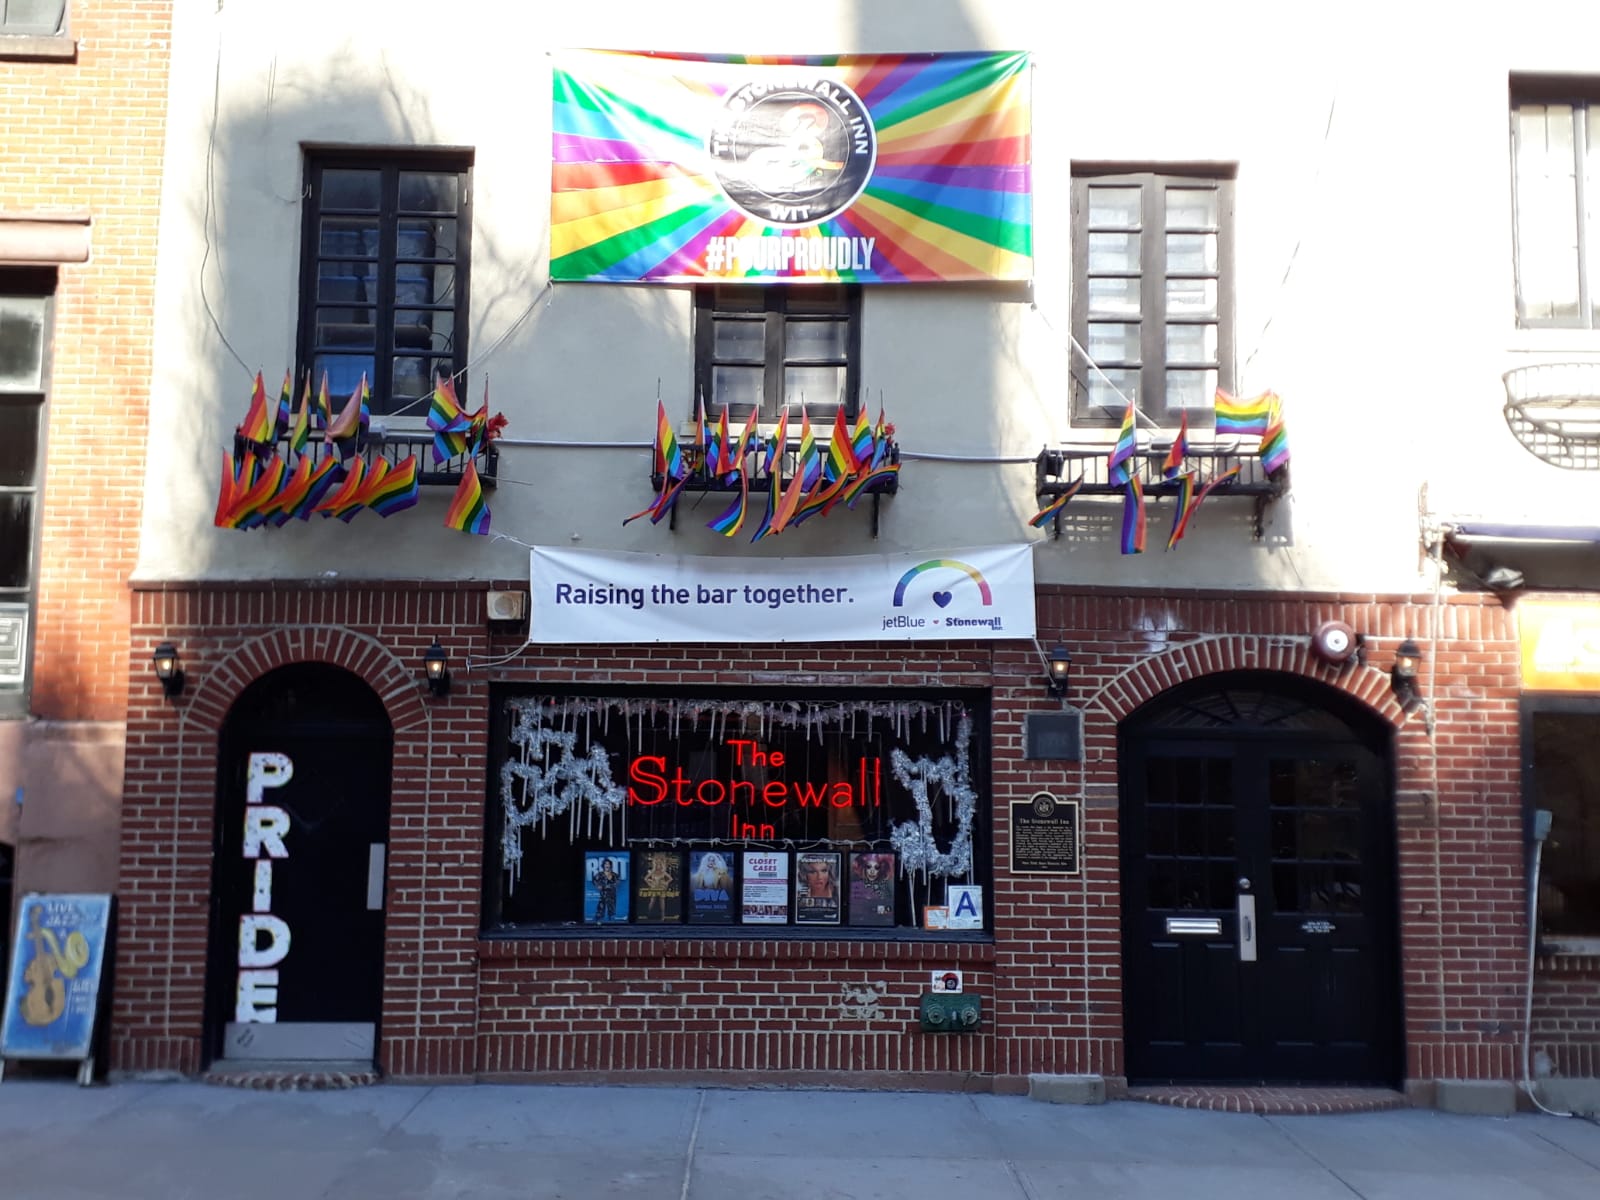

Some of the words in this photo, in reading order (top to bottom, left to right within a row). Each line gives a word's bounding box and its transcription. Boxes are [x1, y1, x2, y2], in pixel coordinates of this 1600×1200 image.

[850, 117, 868, 154] INN
[768, 204, 811, 220] WIT
[705, 236, 876, 271] #POURPROUDLY
[555, 583, 645, 609] Raising
[651, 584, 691, 606] the
[696, 584, 738, 605] bar
[743, 584, 854, 609] together.
[882, 615, 925, 631] jetBlue
[945, 617, 1001, 627] Stonewall
[727, 740, 785, 767] The
[628, 756, 882, 808] Stonewall
[732, 814, 775, 840] Inn
[236, 751, 294, 1023] PRIDE
[955, 891, 977, 917] A
